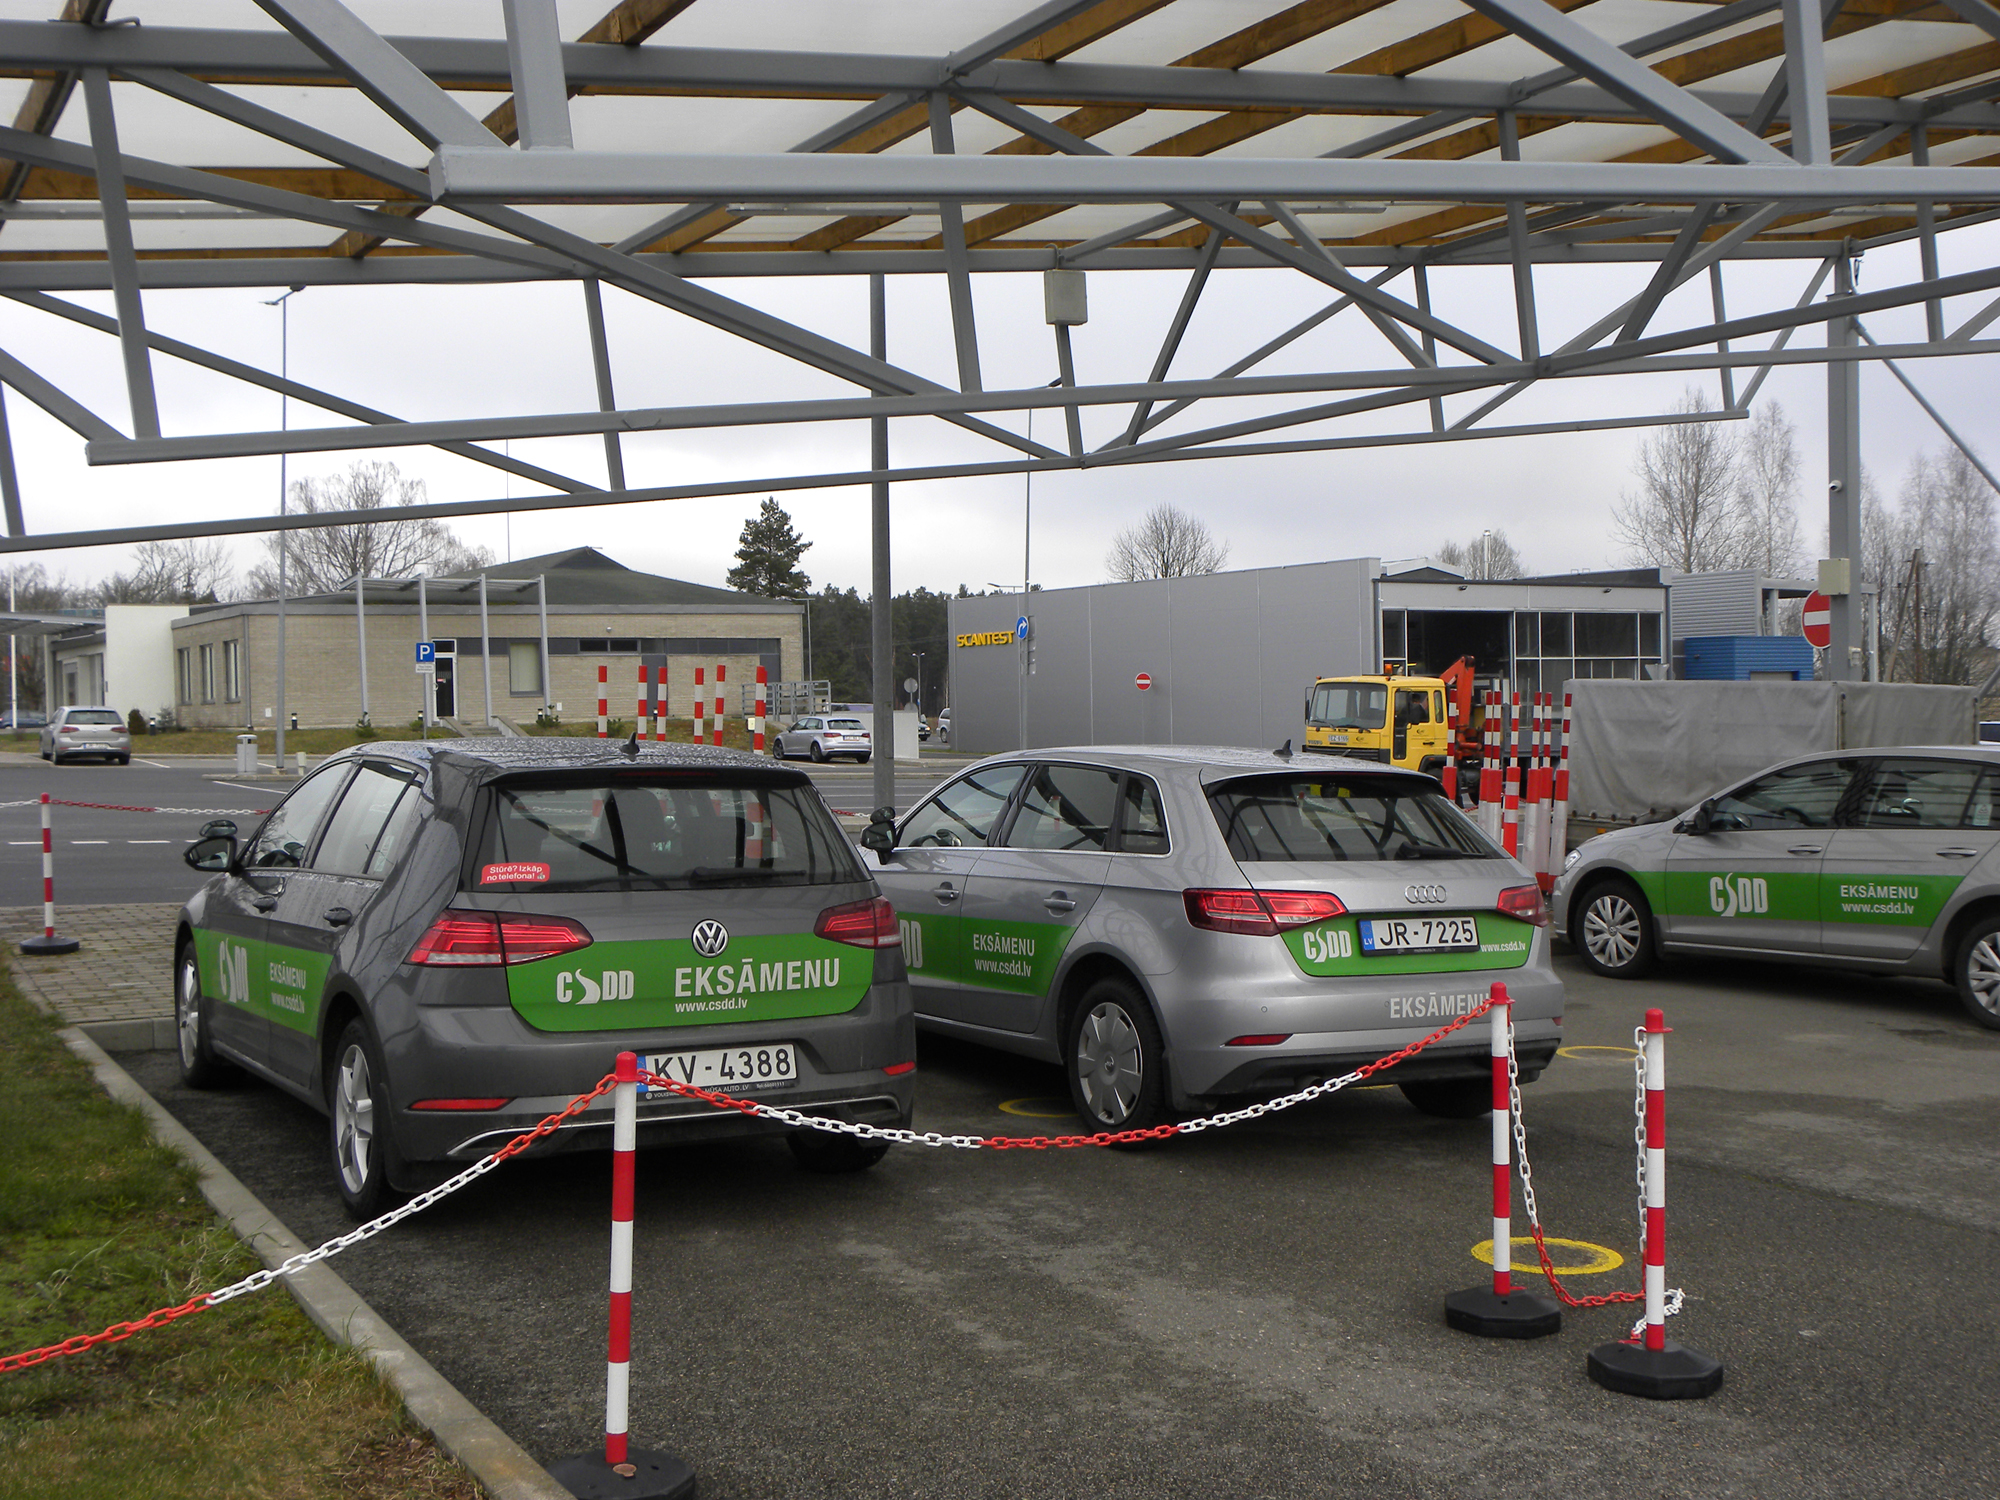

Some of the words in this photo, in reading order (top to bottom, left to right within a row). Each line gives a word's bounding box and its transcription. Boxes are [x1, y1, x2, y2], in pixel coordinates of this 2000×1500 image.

[957, 631, 1015, 648] SCANTEST
[420, 645, 430, 660] P
[489, 865, 517, 873] Stūrē?
[519, 865, 542, 873] Izkāp
[1710, 872, 1768, 917] CSDD
[1840, 883, 1919, 899] EKSĀMENU
[1842, 903, 1914, 914] www.csdd.lv
[1380, 920, 1474, 946] JR-7225
[973, 933, 1035, 957] EKSĀMENU
[1303, 927, 1352, 963] CSDD
[1481, 941, 1526, 952] www.csdd.lv
[270, 961, 306, 990] EKSĀMENU
[675, 958, 840, 997] EKSĀMENU
[974, 959, 1032, 977] www.csdd.lv
[556, 969, 634, 1005] CSDD
[675, 998, 748, 1013] www.csdd.lv
[654, 1048, 791, 1084] KV-4388
